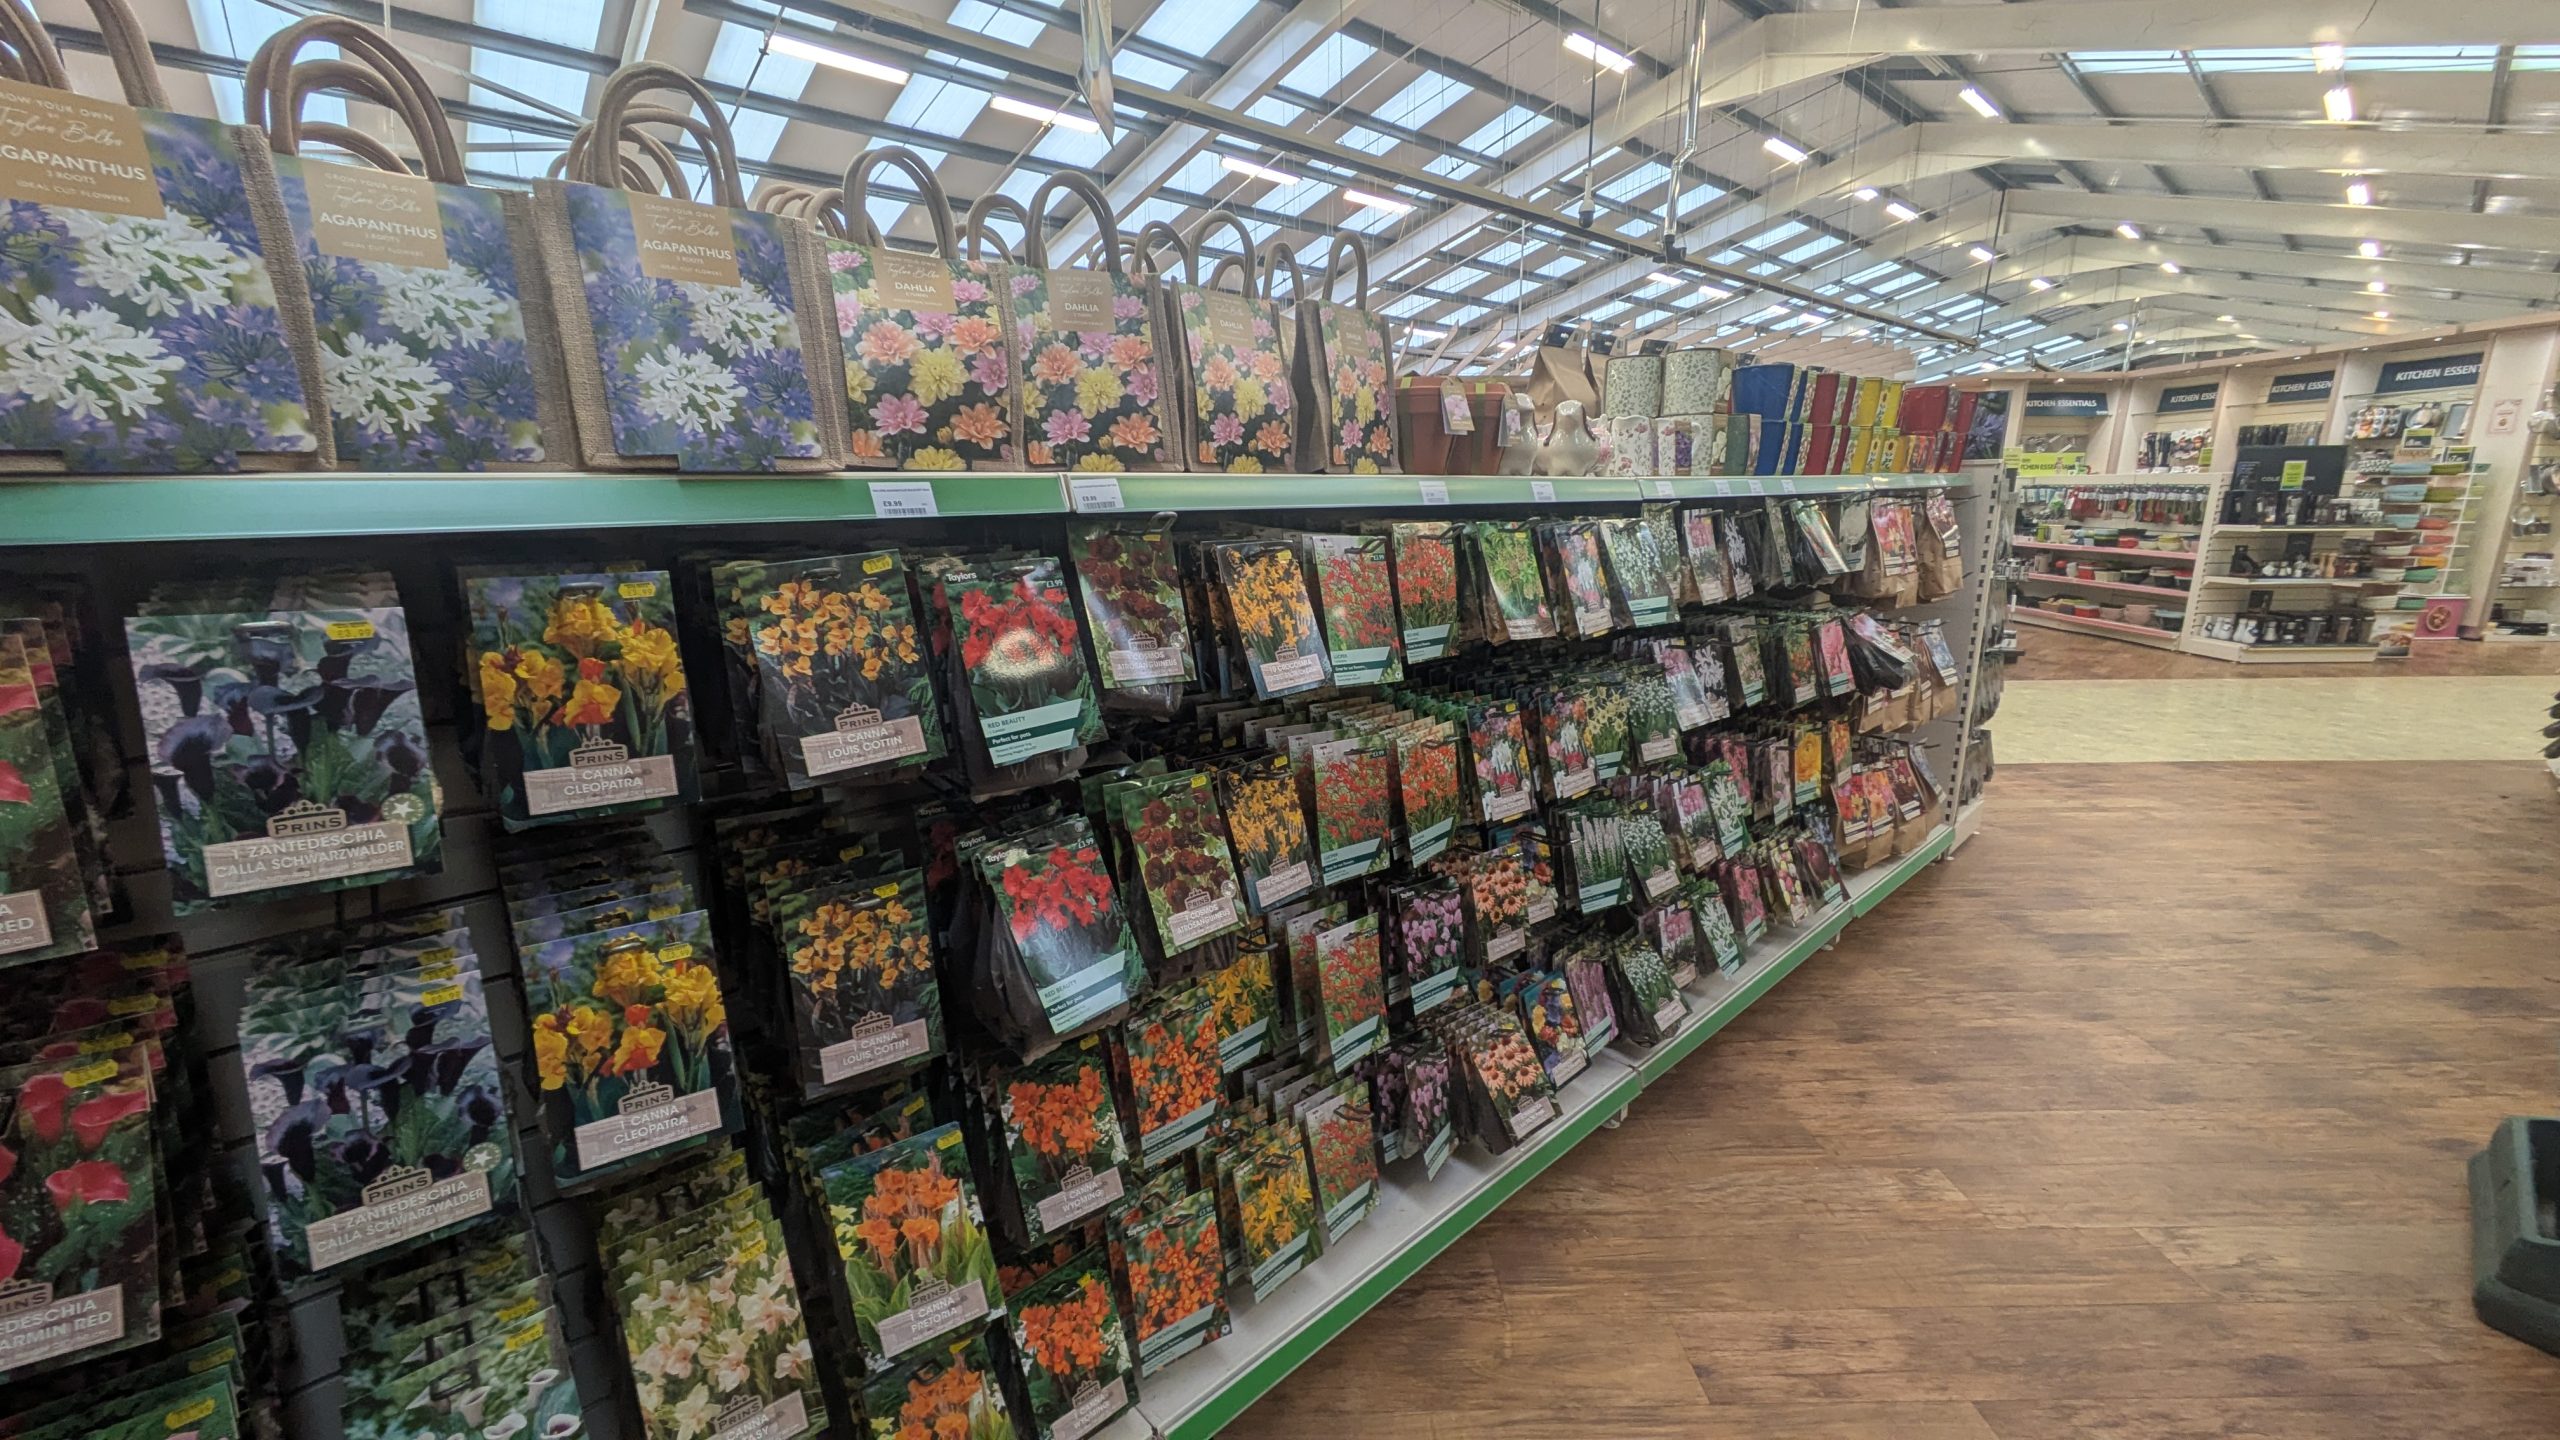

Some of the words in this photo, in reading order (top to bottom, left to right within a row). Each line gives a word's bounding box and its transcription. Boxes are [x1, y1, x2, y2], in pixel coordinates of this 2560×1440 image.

[37, 100, 73, 113] YOUR
[79, 108, 114, 121] OWN
[0, 144, 147, 181] GAPANTHUS
[57, 172, 97, 185] ROOTS
[320, 212, 438, 240] AGAPANTHUS
[643, 239, 732, 260] AGAPANTHUS
[895, 281, 936, 293] DAHLIA
[1064, 302, 1099, 312] DAHLIA
[1219, 319, 1244, 330] DAHLIA
[2396, 370, 2440, 382] KITCHEN
[2271, 383, 2305, 393] KITCHEN
[2026, 400, 2055, 408] KITCHEN
[2057, 399, 2097, 408] ESSENTIALS
[2171, 394, 2199, 403] KITCHEN
[946, 572, 977, 583] Taylors
[1046, 580, 1063, 588] £3.99
[840, 715, 880, 729] PRINS
[987, 721, 1000, 729] RED
[1001, 716, 1026, 726] BEAUTY
[838, 736, 843, 745] 1
[847, 727, 888, 743] CANNA
[992, 735, 1010, 744] Perfect
[1011, 734, 1019, 742] for
[1020, 732, 1031, 740] pots
[827, 744, 860, 759] LOUIS
[862, 736, 903, 751] COTTIN
[574, 751, 625, 766] PRINS
[571, 772, 576, 781] 1
[582, 766, 634, 780] CANNA
[563, 777, 642, 796] CLEOPATRA
[274, 816, 342, 835] PRINS
[232, 849, 239, 859] 1
[249, 829, 387, 858] ZANTEDESCHIA
[959, 835, 986, 848] Taylors
[1079, 838, 1094, 848] £3.99
[215, 862, 266, 878] CALLA
[271, 840, 405, 870] SCHWARZWALDER
[1188, 897, 1209, 906] PRINS
[1190, 903, 1219, 919] COSMOS
[1177, 910, 1230, 934] ATROSANGUINEUS
[1045, 990, 1055, 998] RED
[1056, 980, 1077, 992] BEAUTY
[855, 1021, 891, 1037] PRINS
[1127, 1018, 1149, 1031] Taylors
[861, 1032, 898, 1048] CANNA
[842, 1051, 872, 1066] LOUIS
[874, 1039, 909, 1056] COTTIN
[623, 1092, 670, 1112] PRINS
[620, 1120, 625, 1129] 1
[631, 1105, 680, 1126] CANNA
[613, 1115, 688, 1144] CLEOPATRA
[368, 1176, 428, 1202] PRINS
[1064, 1173, 1091, 1188] PRINS
[1069, 1181, 1098, 1199] CANNA
[332, 1223, 338, 1232] 1
[348, 1181, 468, 1228] ZANTEDESCHIA
[1062, 1190, 1104, 1212] WYOMING
[316, 1232, 362, 1252] CALLA
[366, 1188, 485, 1235] SCHWARZWALDER
[1126, 1224, 1148, 1237] Taylors
[0, 1291, 47, 1313] INS
[911, 1286, 946, 1306] PRINS
[918, 1296, 955, 1318] CANNA
[75, 1312, 112, 1331] RED
[911, 1308, 957, 1333] PRETORIA
[718, 1402, 760, 1430] PRINS
[727, 1414, 769, 1440] CANNA
